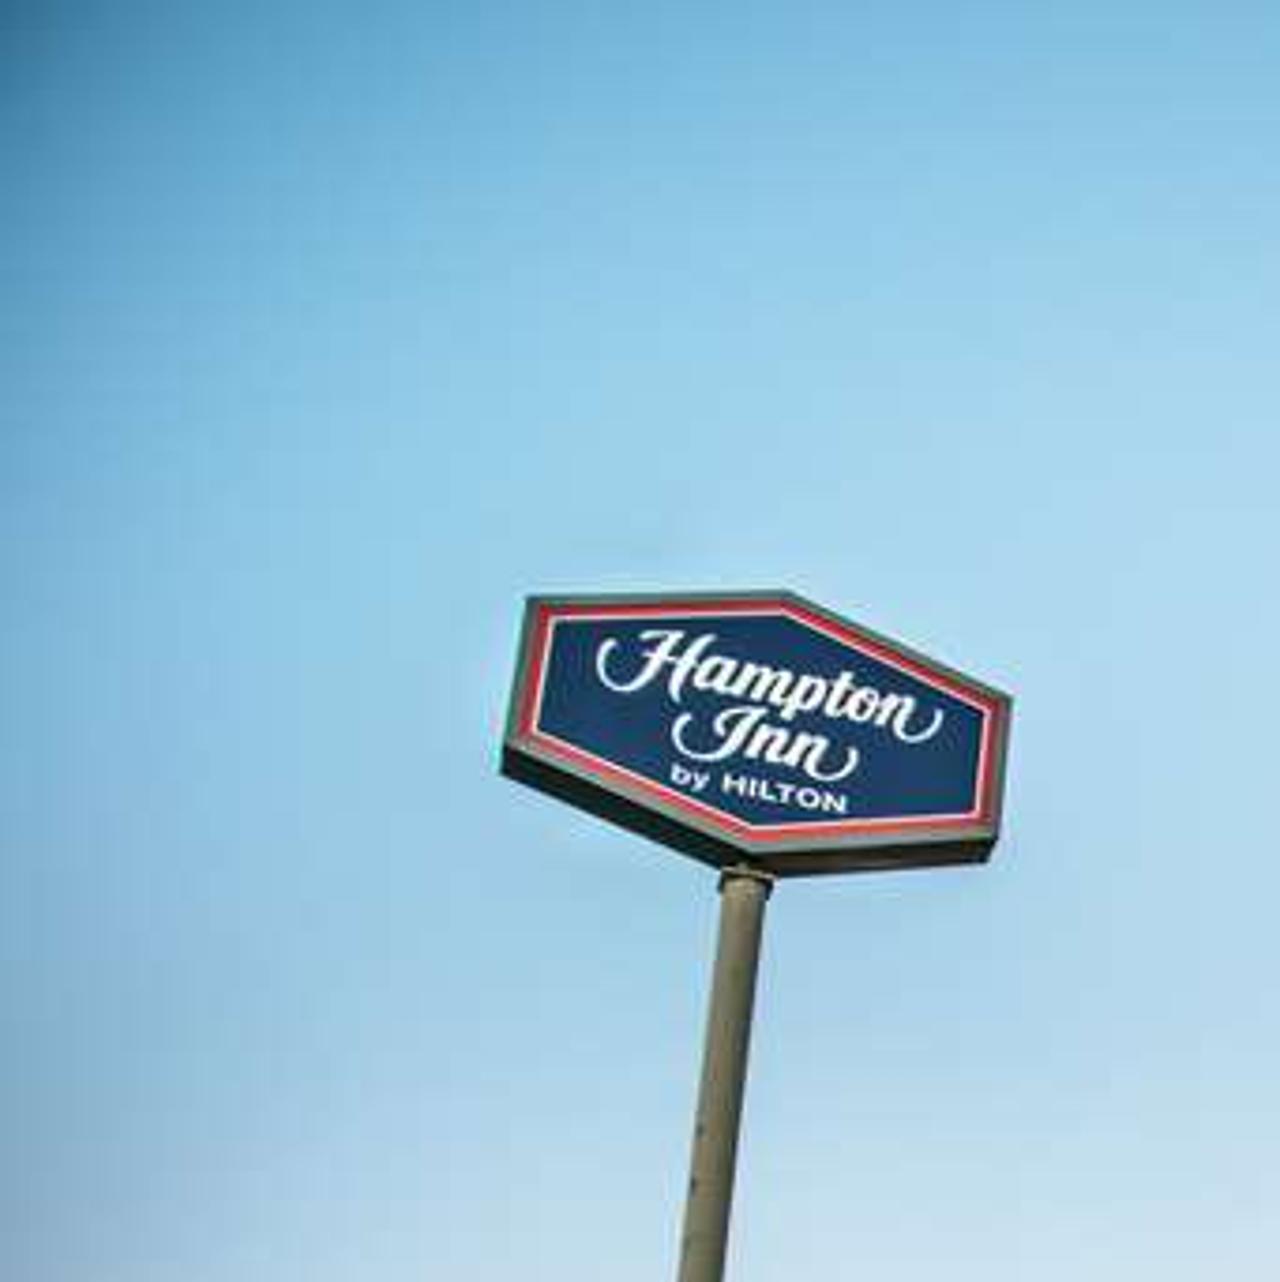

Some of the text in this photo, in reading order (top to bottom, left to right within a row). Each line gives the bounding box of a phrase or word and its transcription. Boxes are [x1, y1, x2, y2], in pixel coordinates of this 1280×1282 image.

[596, 629, 943, 744] Hampton
[671, 704, 859, 781] Inn
[671, 764, 848, 814] by HILTON
